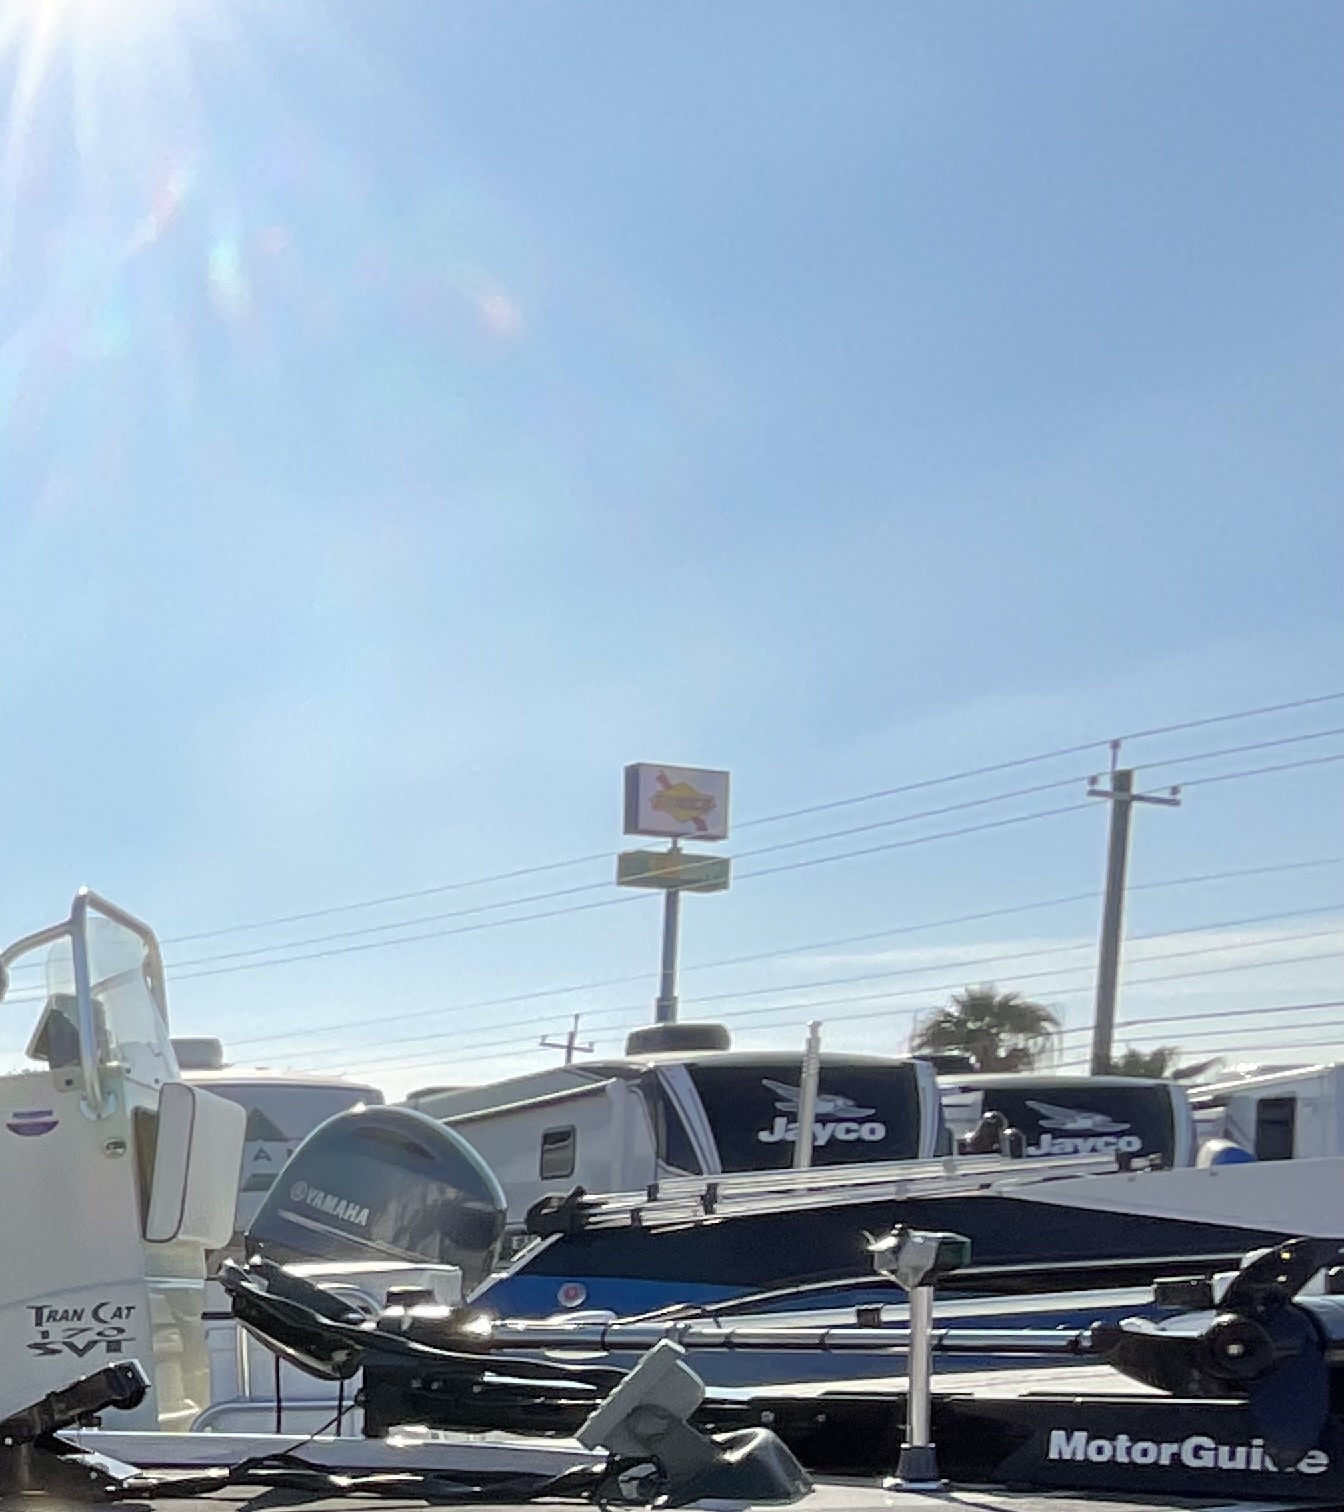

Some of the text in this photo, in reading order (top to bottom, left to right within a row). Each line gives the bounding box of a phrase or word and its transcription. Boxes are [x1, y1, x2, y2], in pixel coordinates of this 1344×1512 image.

[757, 1116, 886, 1146] Jayco
[1026, 1133, 1142, 1154] Jayco
[306, 1187, 370, 1226] YAMAHA
[26, 1337, 136, 1358] SVT
